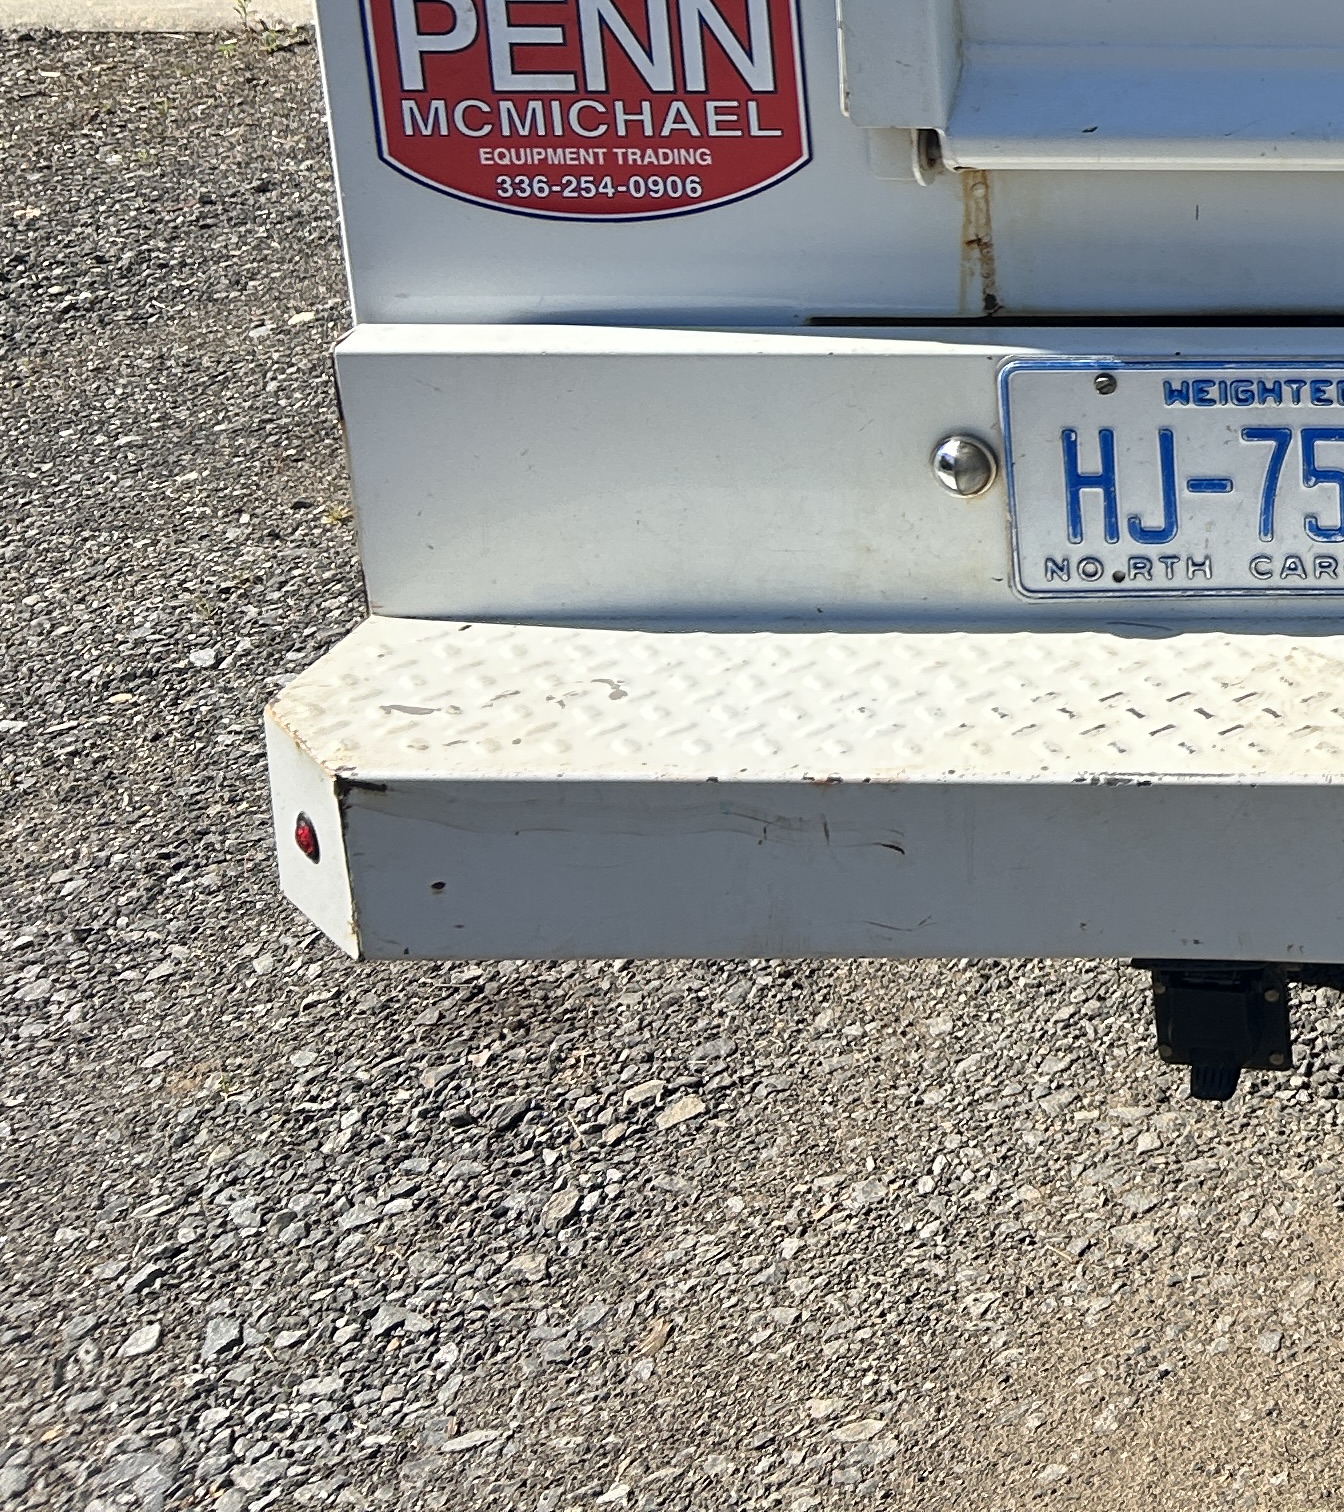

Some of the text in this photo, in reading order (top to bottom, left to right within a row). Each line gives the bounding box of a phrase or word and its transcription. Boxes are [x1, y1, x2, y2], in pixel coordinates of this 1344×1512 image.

[401, 99, 784, 138] MCMICHAEL
[479, 148, 713, 166] EQUIPMENT TRADING
[496, 175, 703, 198] 336-254-0906
[1045, 555, 1213, 583] NORTH
